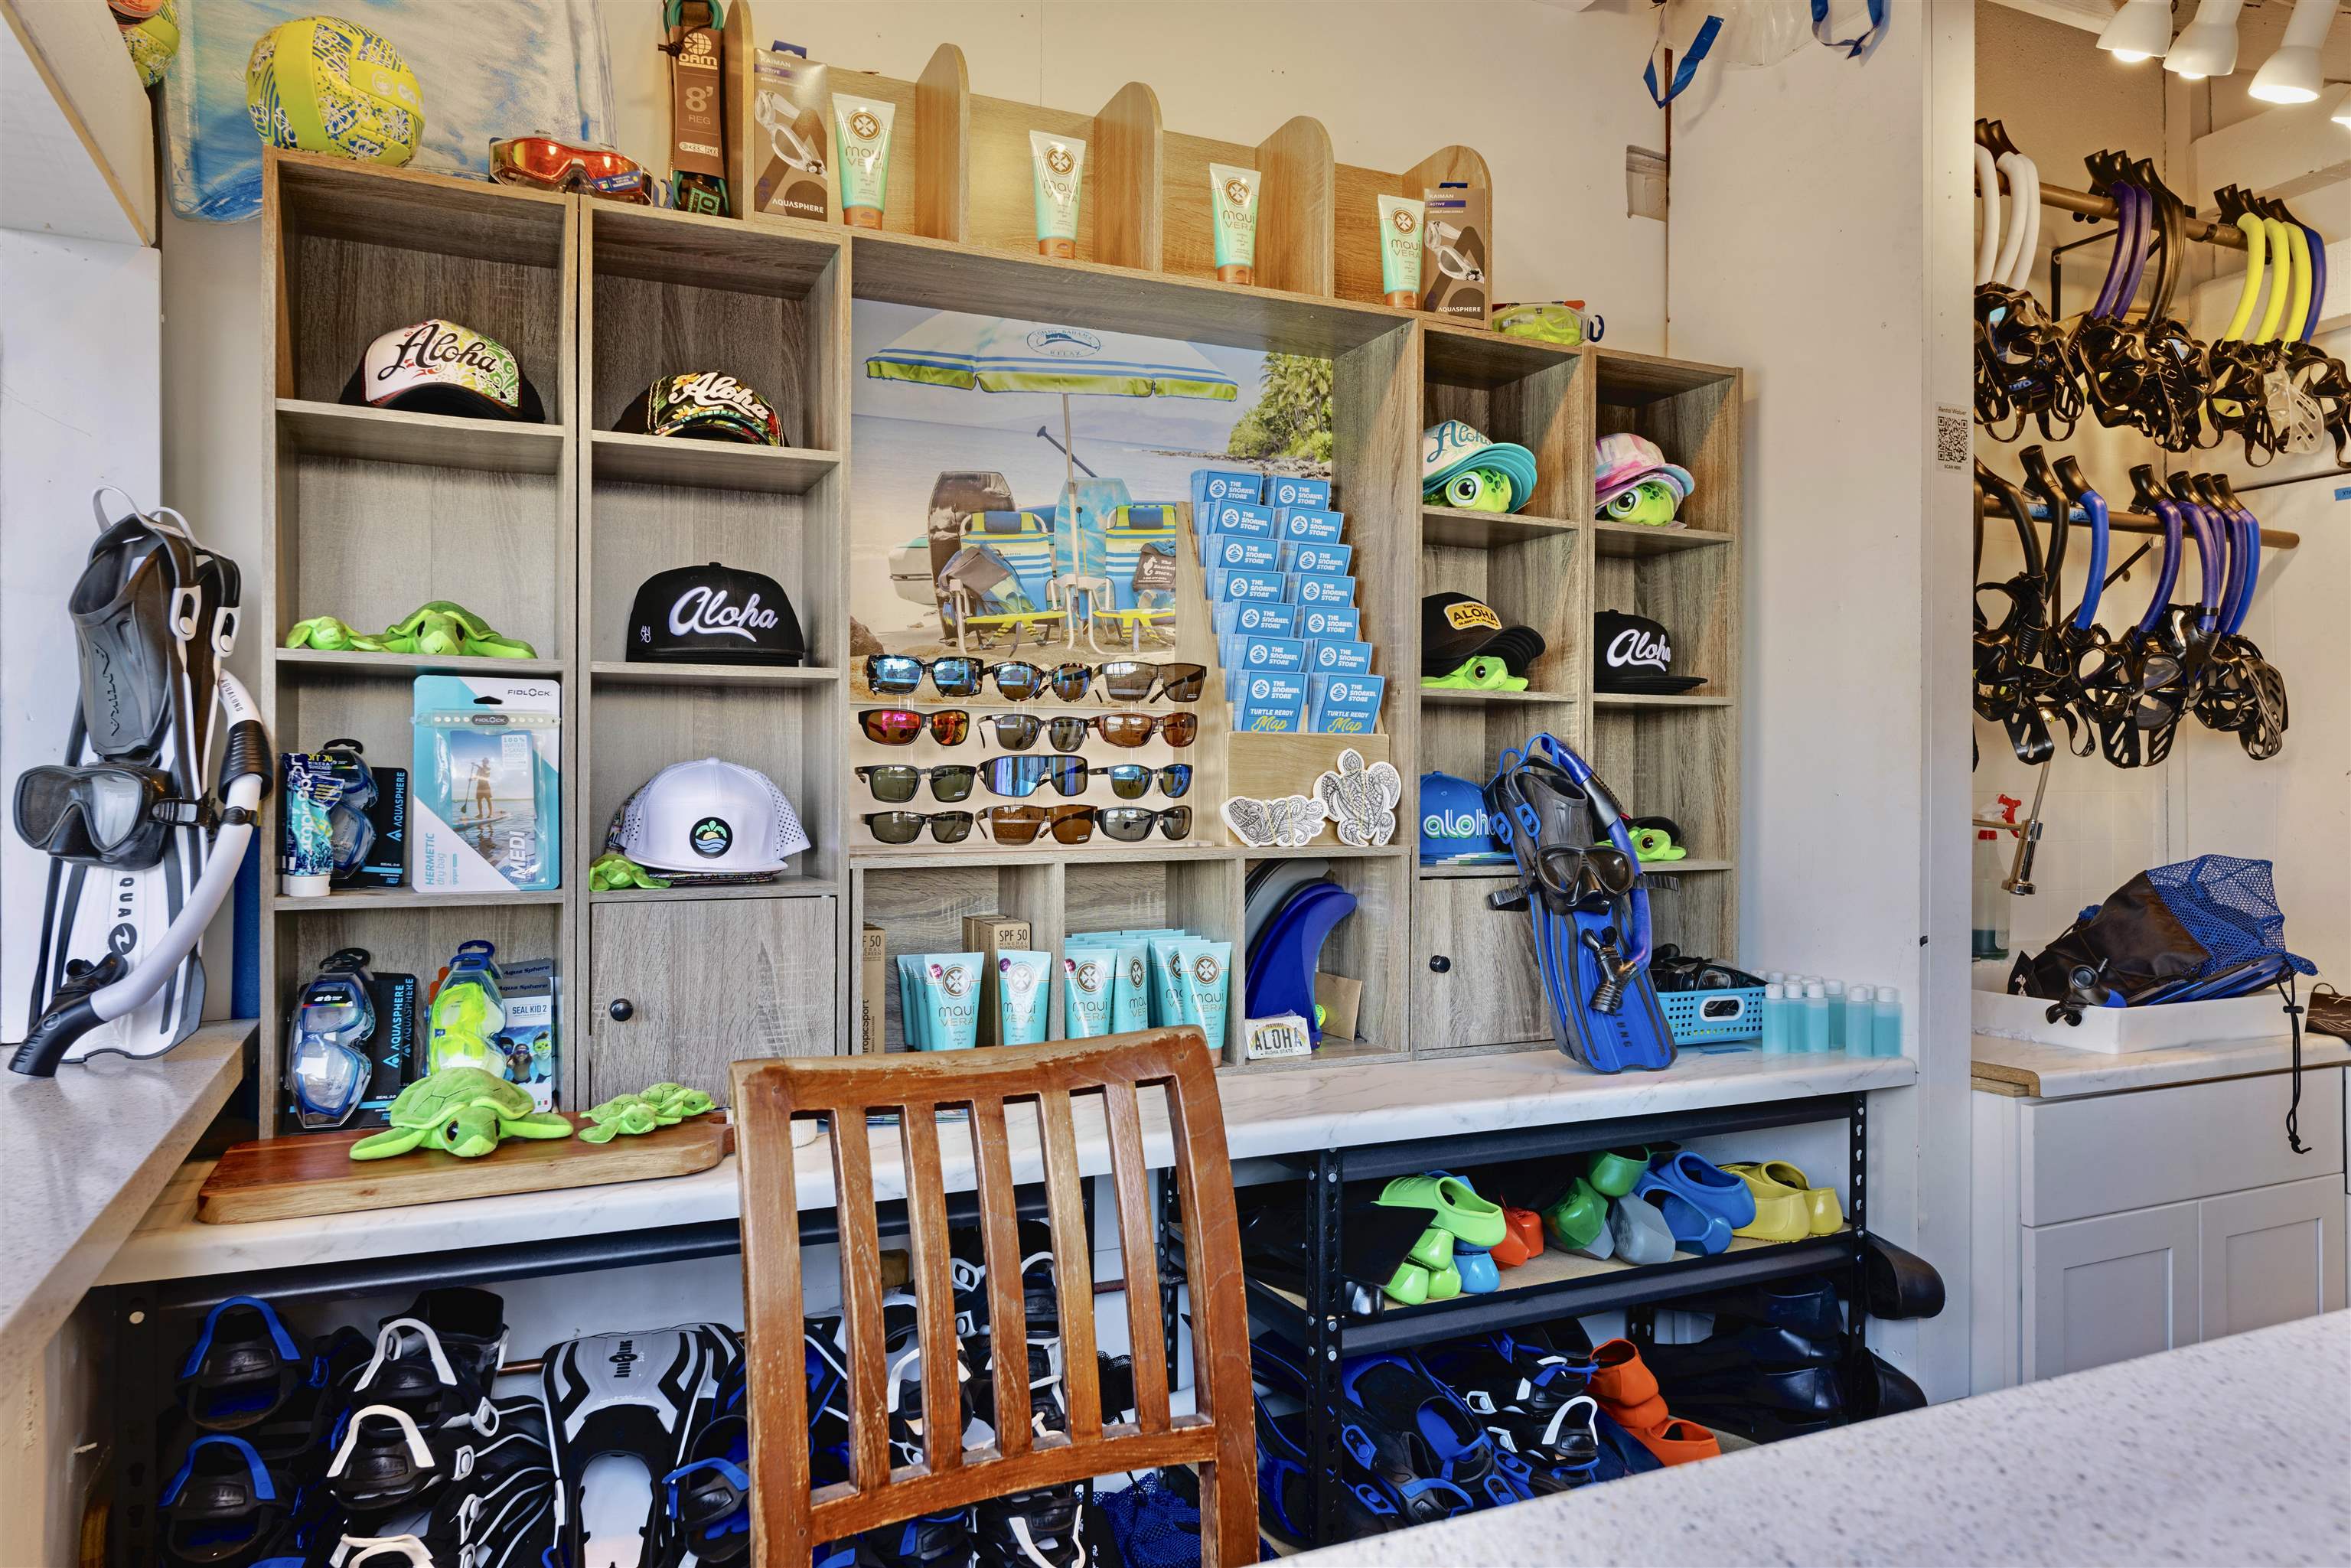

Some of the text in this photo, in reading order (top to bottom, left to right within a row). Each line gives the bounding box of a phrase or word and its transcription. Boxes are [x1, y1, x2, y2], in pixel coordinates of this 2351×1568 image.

[760, 57, 791, 68] KAIMAN
[689, 115, 711, 125] REG
[1045, 191, 1078, 204] VRA
[772, 198, 824, 214] AQUASPHERE
[1223, 210, 1255, 224] maui
[1224, 220, 1255, 233] VERA
[1391, 239, 1421, 251] maui
[1393, 249, 1421, 259] VERA
[377, 324, 497, 381] Aloha
[668, 371, 770, 421] Aloha
[1241, 518, 1267, 526] SNORKEL
[668, 586, 779, 643] Aloha
[1454, 608, 1498, 622] ALOHA
[507, 688, 550, 697] FIDLOCK
[1251, 716, 1288, 732] Map
[1327, 717, 1362, 733] Map
[394, 771, 406, 826] AQUASPHERE
[426, 832, 435, 885] HERMETIC
[510, 831, 527, 879] MEDI
[118, 876, 135, 918] QUA
[870, 935, 881, 947] 50
[999, 929, 1028, 942] SPF 50
[1192, 989, 1224, 1002] maui
[1003, 1001, 1035, 1014] maui
[1072, 997, 1107, 1012] maui
[1129, 996, 1147, 1009] mau
[1193, 1004, 1224, 1012] VERA
[512, 1006, 530, 1015] SEAL
[938, 1002, 975, 1017] maui
[1130, 1008, 1146, 1017] VER
[391, 985, 404, 1051] AQUASPHERE
[941, 1017, 974, 1027] VERA
[1003, 1014, 1035, 1023] VERA
[1074, 1012, 1107, 1022] VERA
[1255, 1027, 1303, 1051] ALOHA
